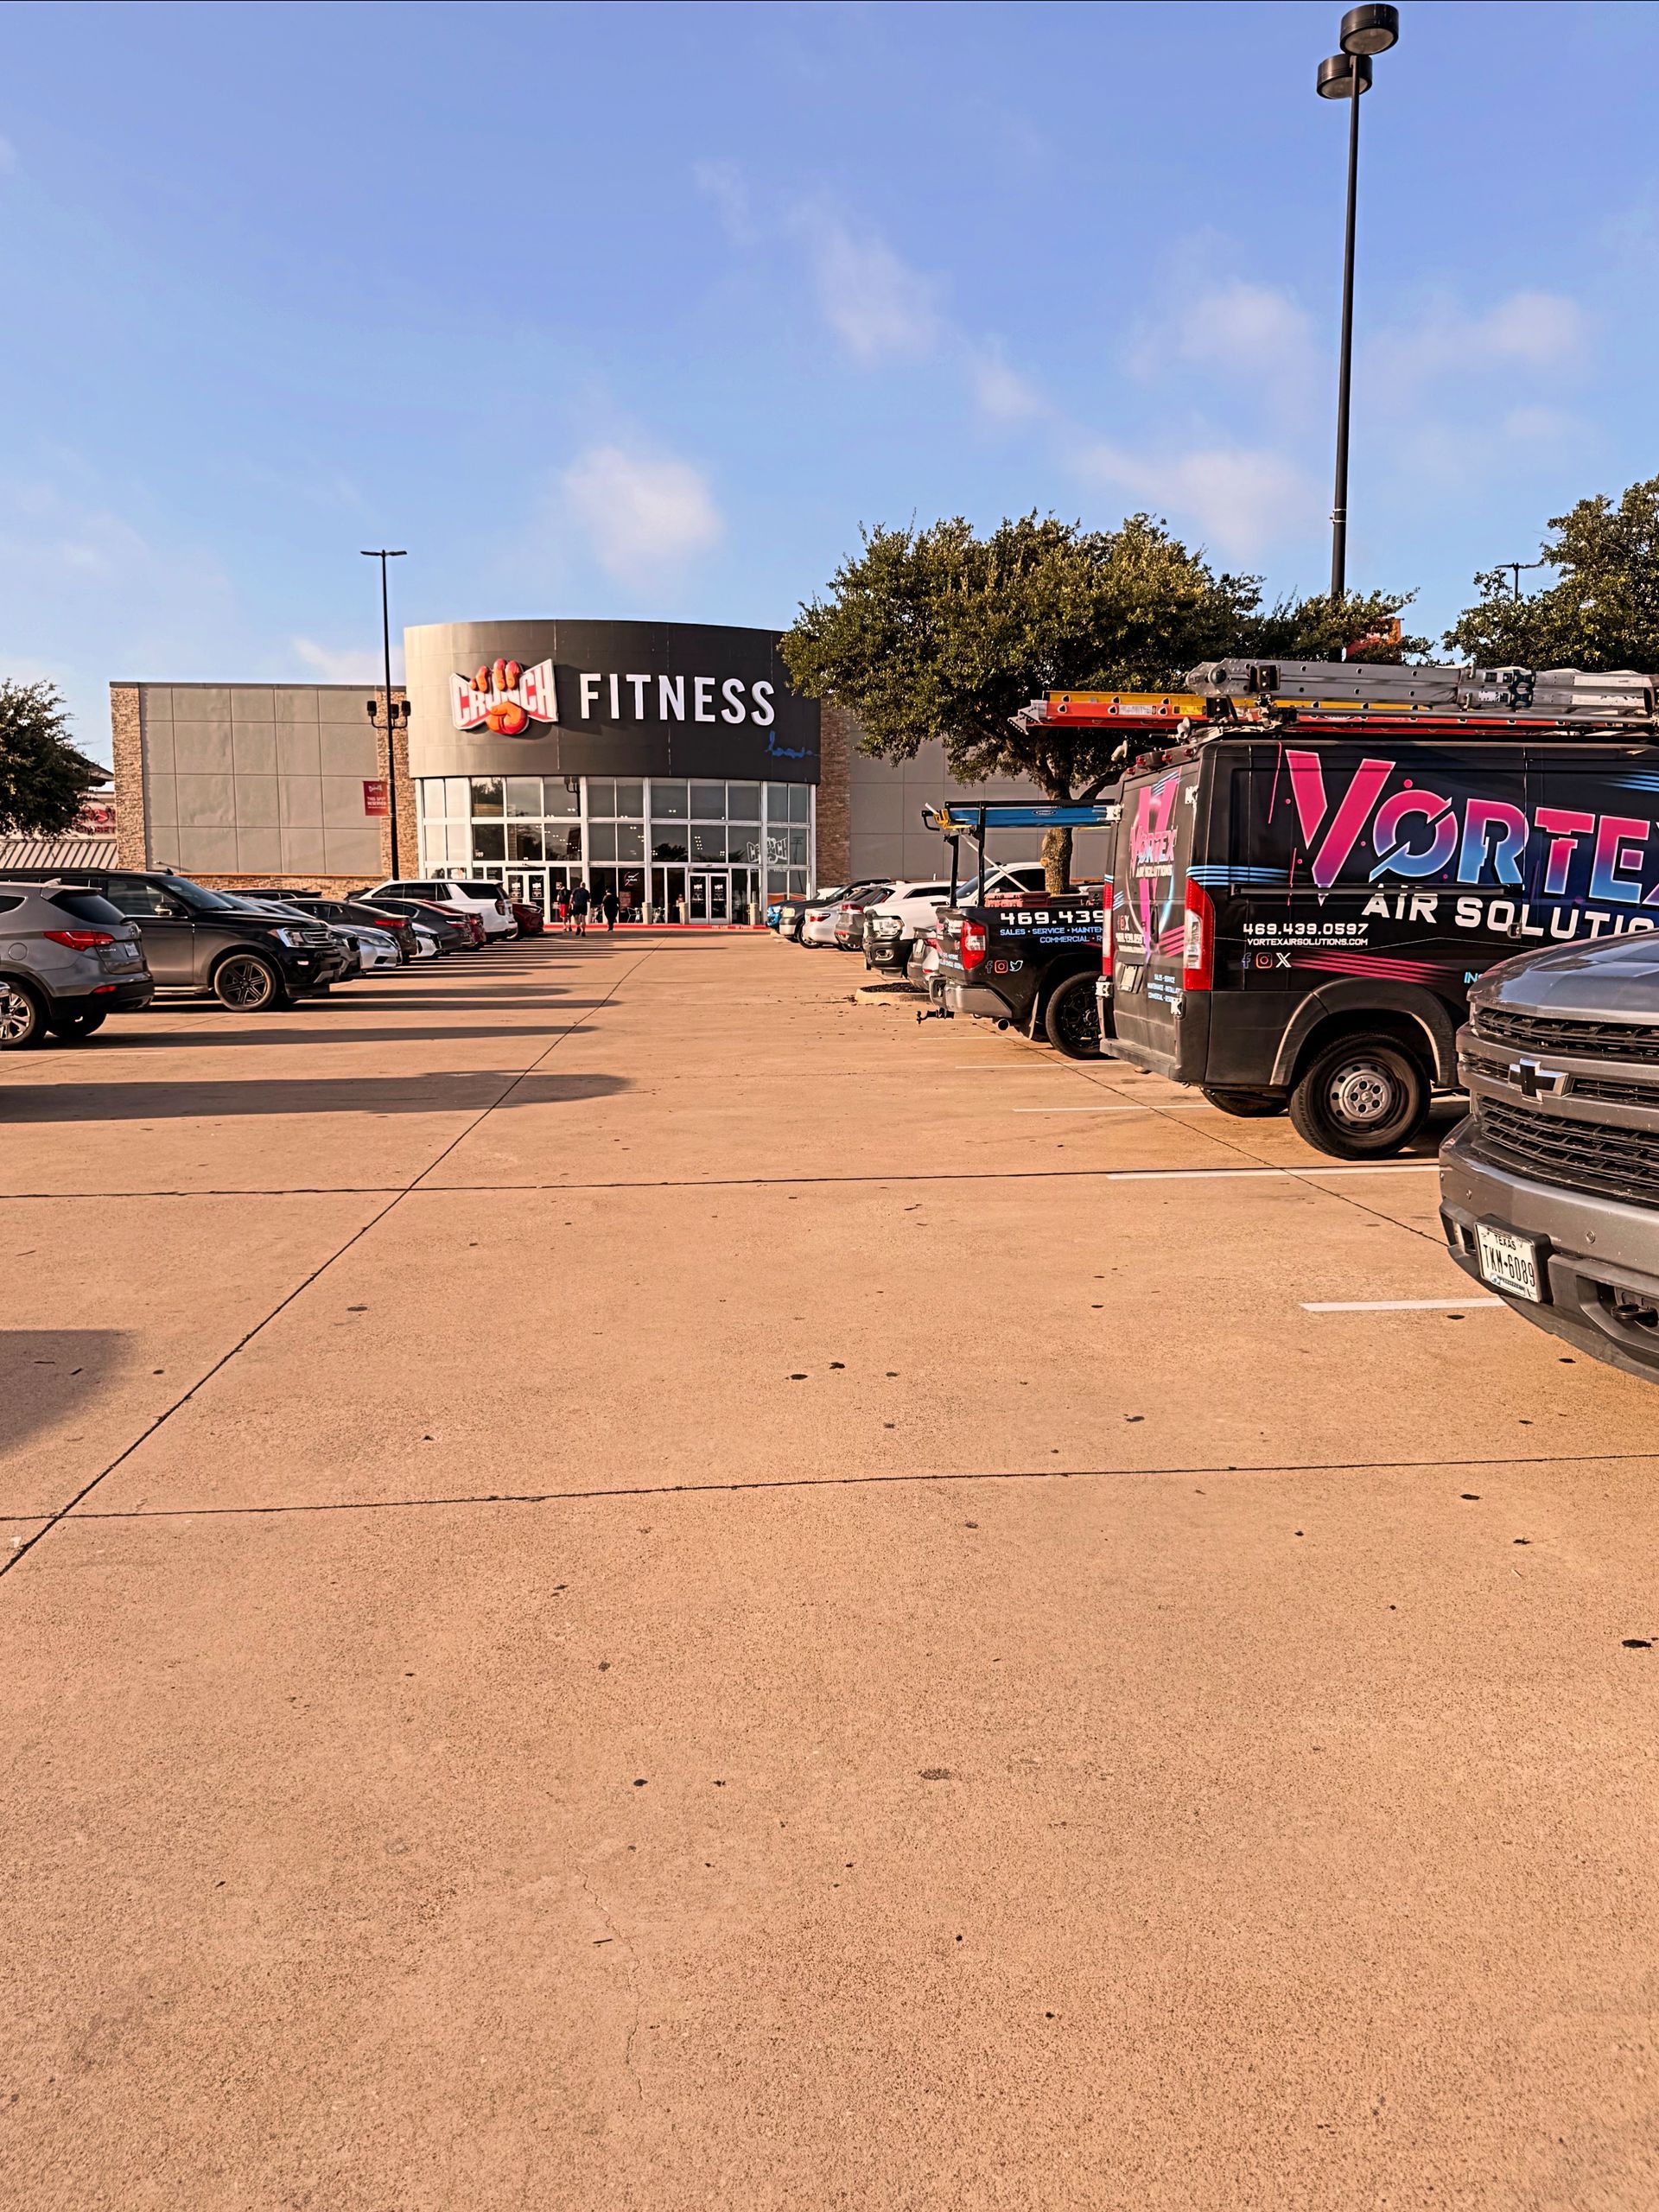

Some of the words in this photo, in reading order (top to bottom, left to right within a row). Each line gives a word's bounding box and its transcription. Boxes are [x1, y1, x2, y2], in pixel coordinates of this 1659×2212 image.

[451, 662, 556, 728] CRUNCH
[580, 674, 775, 726] FITNESS
[1285, 749, 1659, 906] VORTE
[1130, 828, 1177, 878] VORTEX
[1000, 911, 1103, 925] 469.439
[1362, 884, 1438, 923] AIR
[1243, 923, 1369, 935] 469.439.0597
[1494, 1234, 1516, 1250] TEXAS
